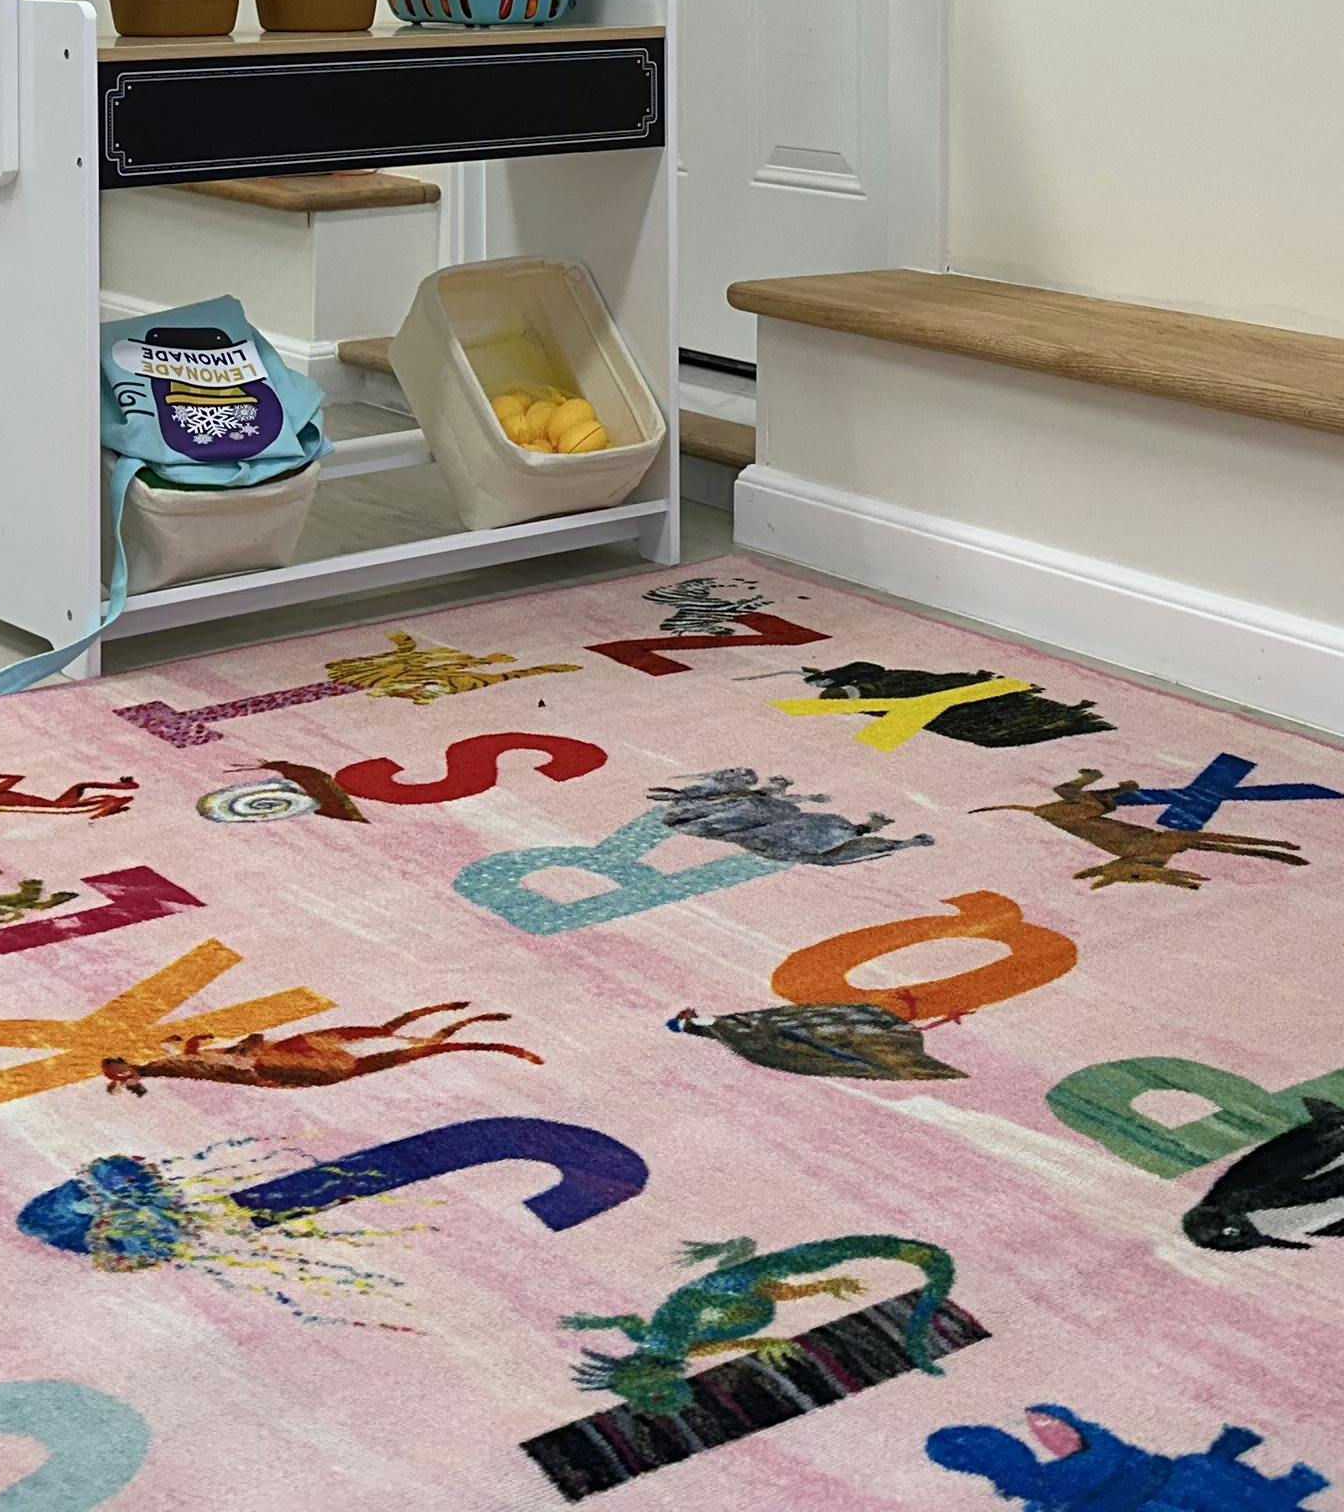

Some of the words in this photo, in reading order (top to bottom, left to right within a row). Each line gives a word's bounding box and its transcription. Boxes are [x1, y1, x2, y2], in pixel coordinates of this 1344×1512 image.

[141, 346, 247, 366] LIMONADE
[141, 360, 258, 384] LEMONADE
[768, 677, 1044, 752] Y
[335, 732, 608, 806] S
[454, 807, 796, 936] R
[771, 890, 1078, 1021] Q
[231, 1117, 649, 1232] J
